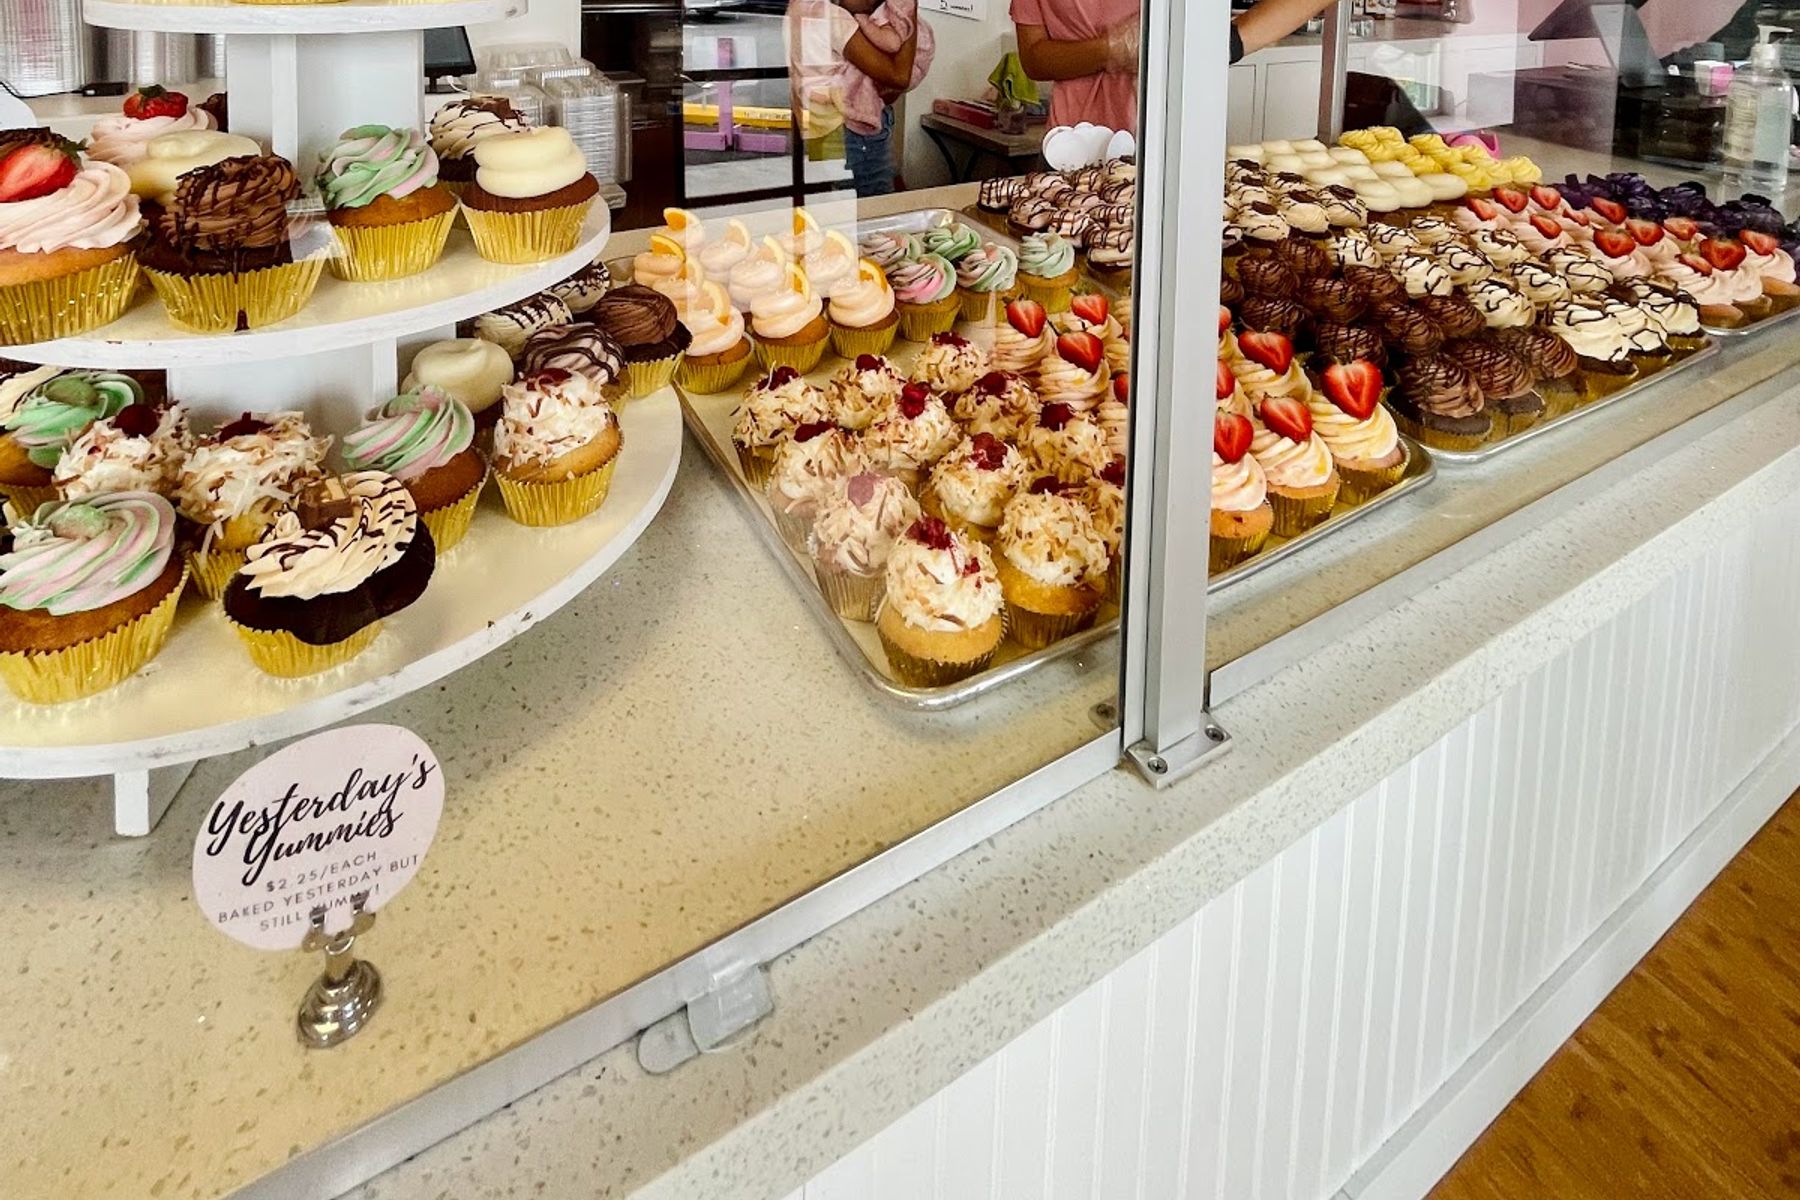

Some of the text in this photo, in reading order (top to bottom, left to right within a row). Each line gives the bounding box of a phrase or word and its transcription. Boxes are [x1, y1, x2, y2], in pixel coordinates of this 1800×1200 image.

[206, 752, 437, 856] Yesterday's
[242, 804, 404, 887] Yummies
[218, 854, 419, 923] BAKED YESTERDAY BUT
[260, 912, 305, 932] STILL
